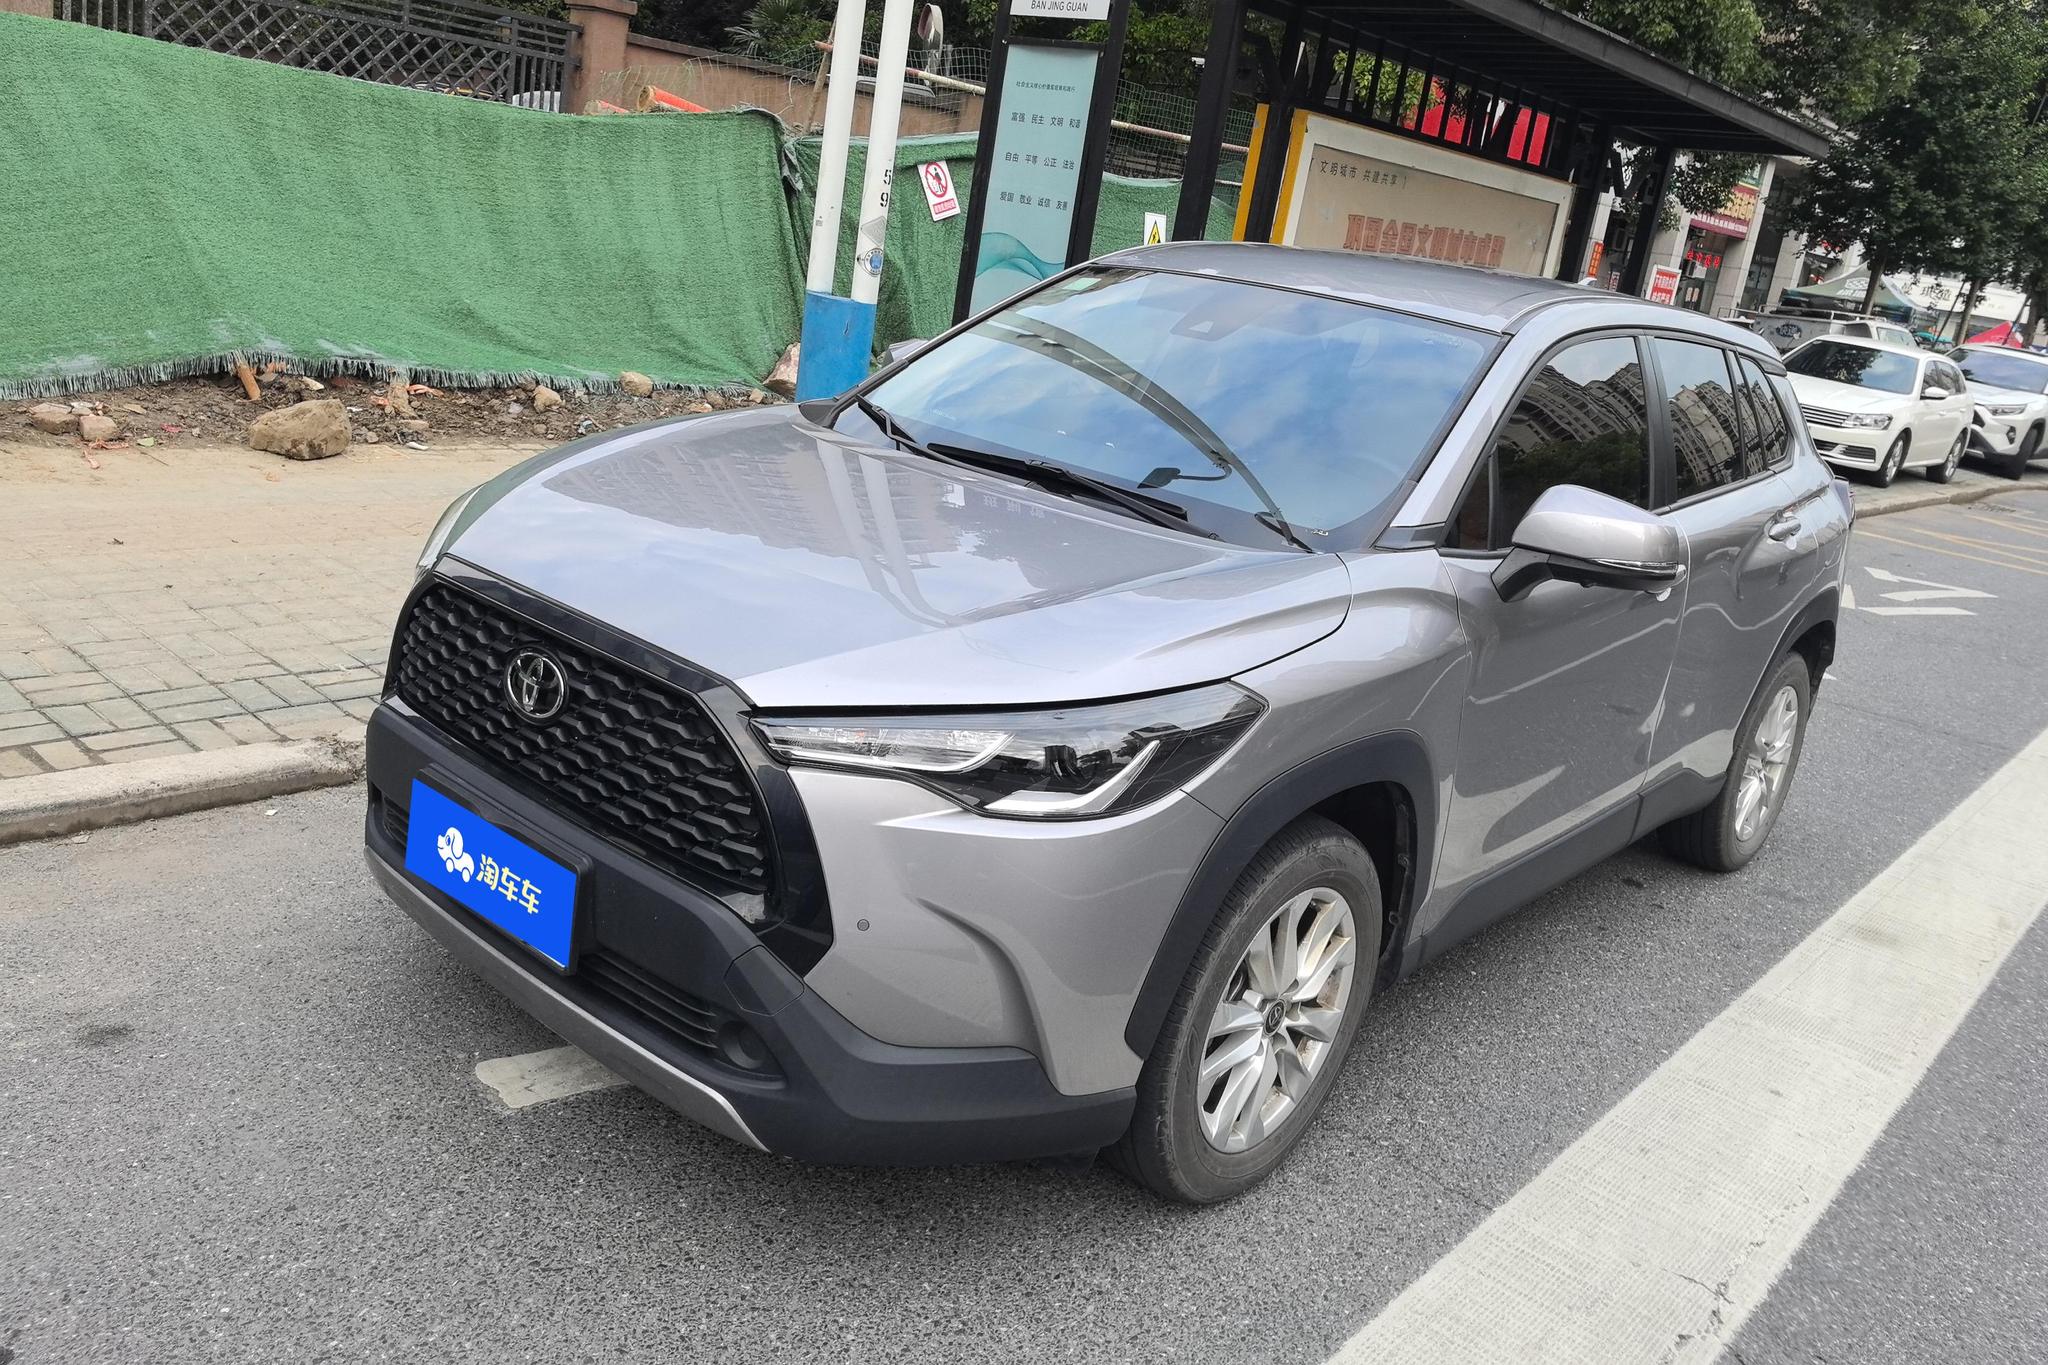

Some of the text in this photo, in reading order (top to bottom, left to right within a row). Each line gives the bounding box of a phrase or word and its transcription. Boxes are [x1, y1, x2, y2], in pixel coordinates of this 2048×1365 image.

[1031, 0, 1088, 12] BAN JING GUAN
[1011, 112, 1081, 129] 富强 民主 文明 和谐
[1005, 152, 1075, 170] 自由 平等 公正 法治
[1320, 160, 1358, 178] 文明城市
[1000, 191, 1068, 211] 爱国 敬业 诚信 友善
